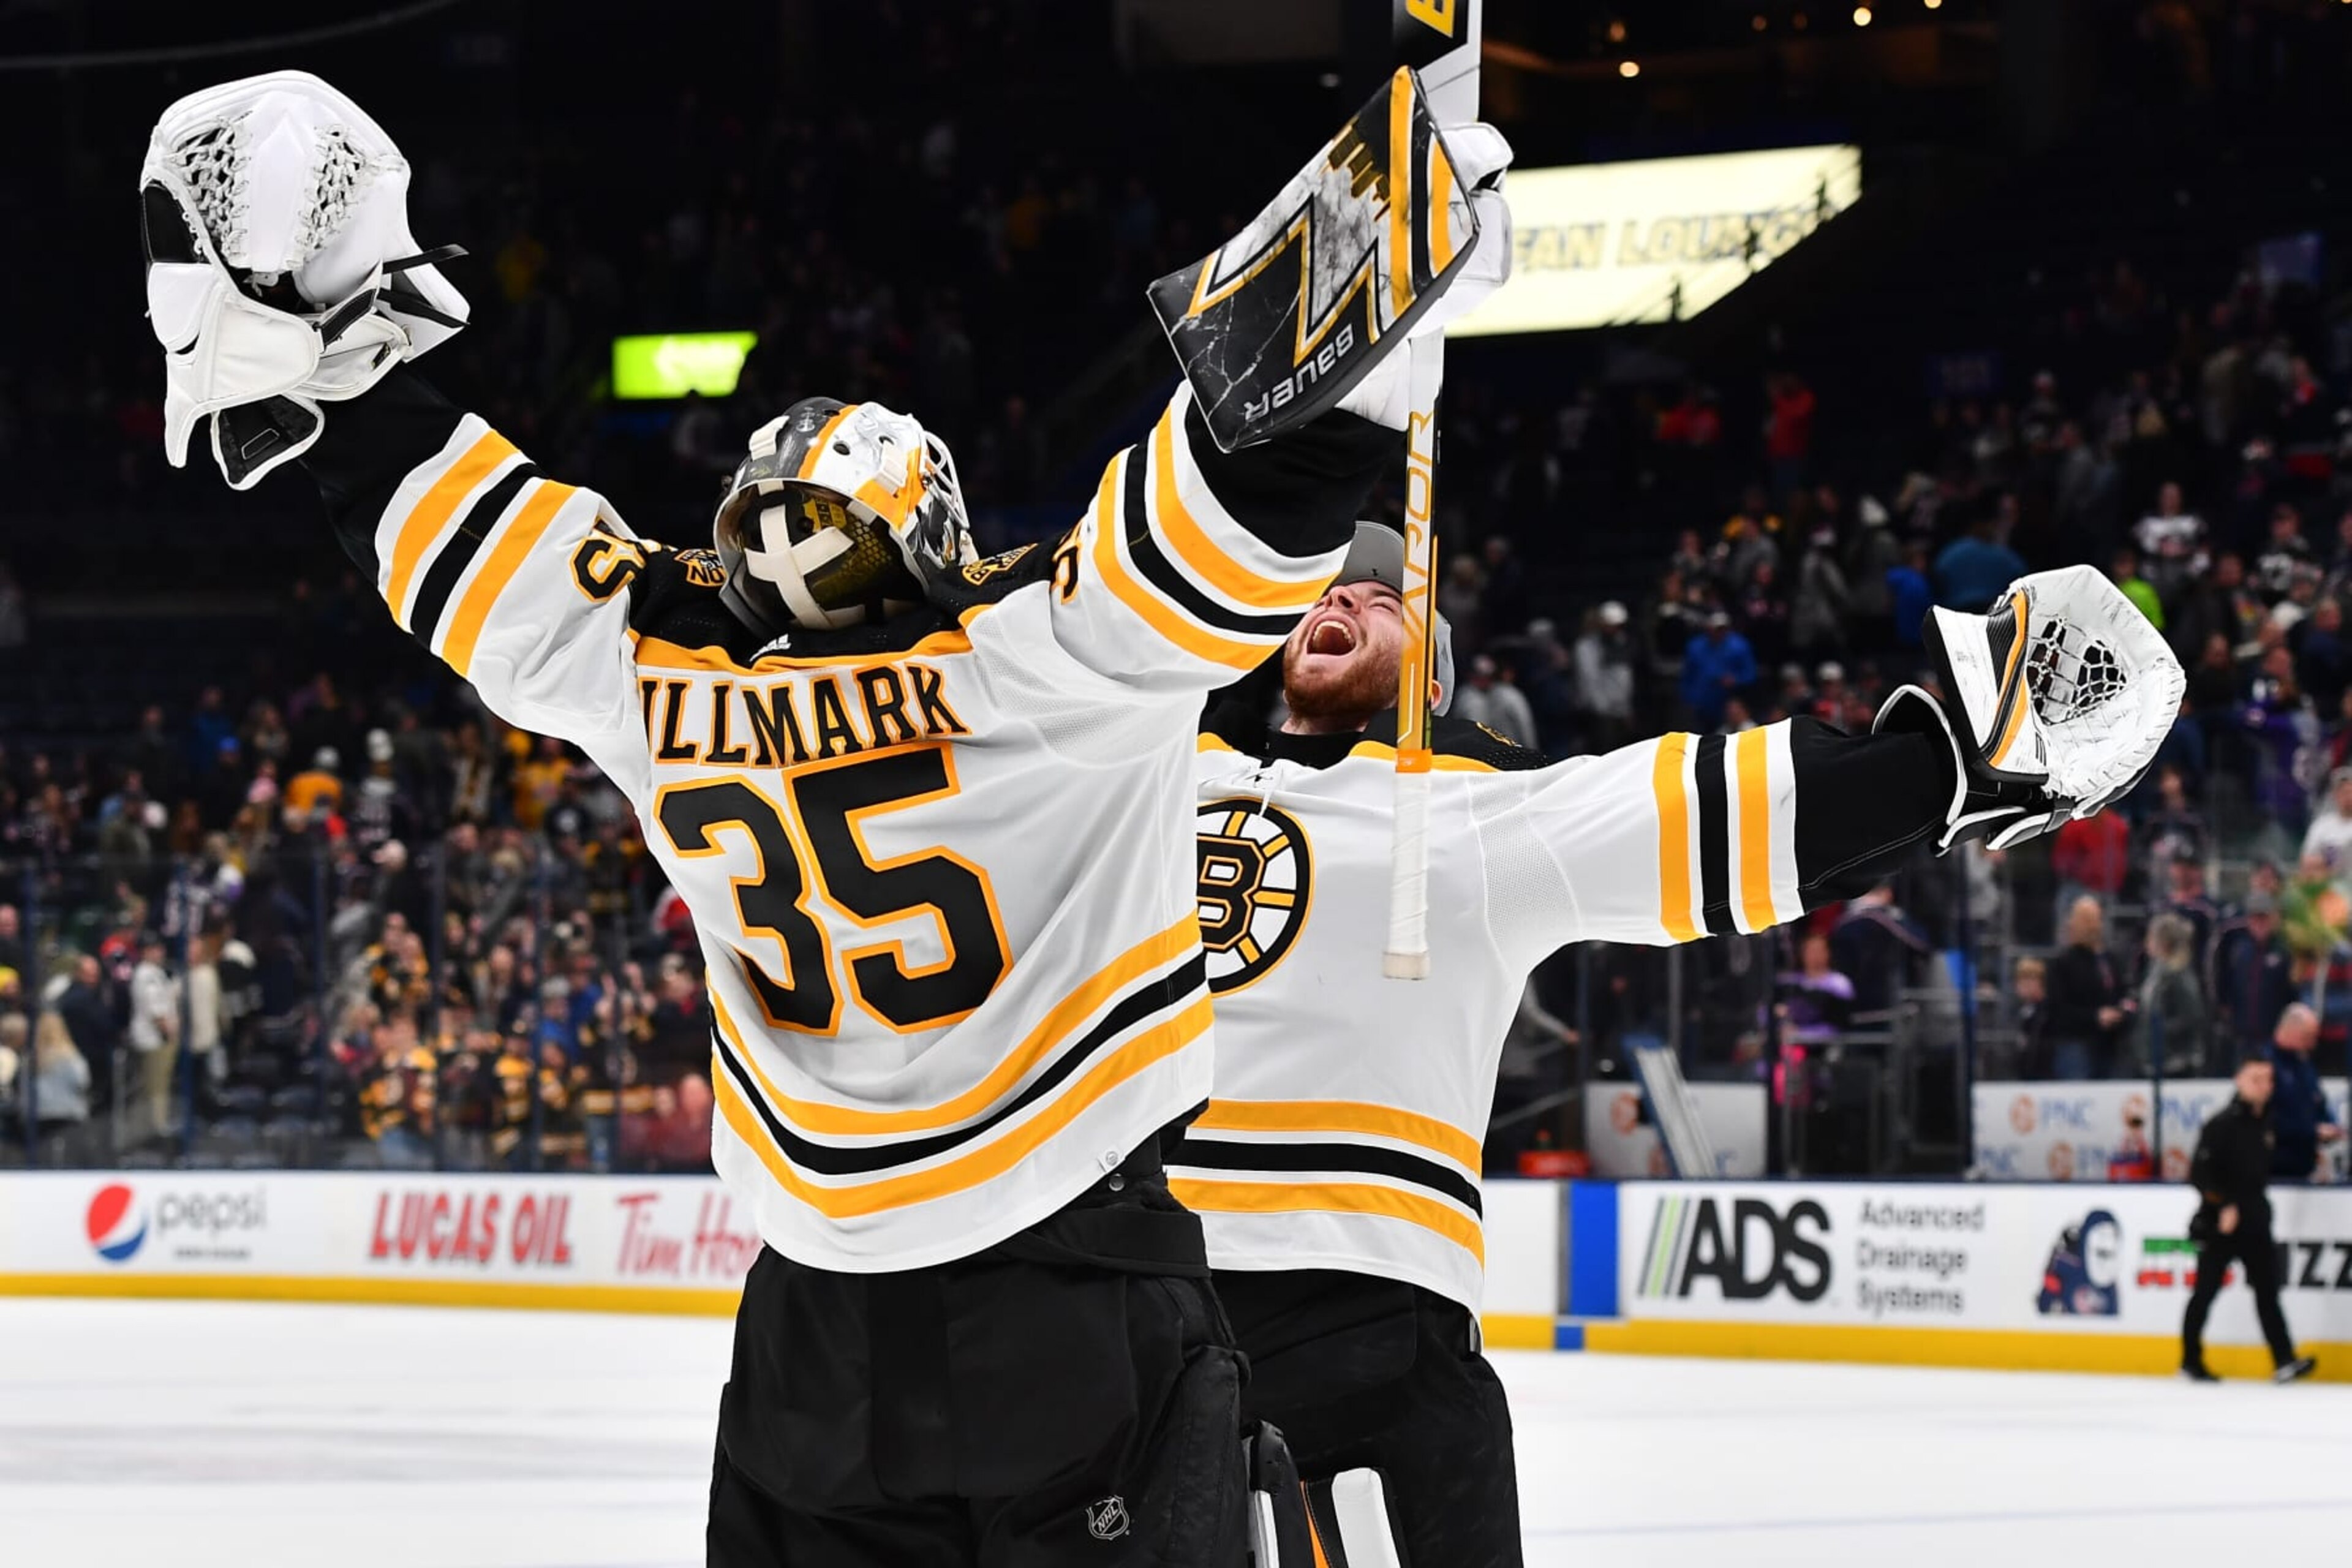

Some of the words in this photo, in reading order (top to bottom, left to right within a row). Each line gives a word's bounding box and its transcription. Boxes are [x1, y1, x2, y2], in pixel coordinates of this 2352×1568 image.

[654, 742, 1014, 1037] 35
[156, 1186, 268, 1241] pepsi
[370, 1191, 500, 1264] LUCAS
[512, 1194, 571, 1264] OIL
[614, 1191, 682, 1275] Tim
[1859, 1198, 1986, 1231] Advanced
[1677, 1197, 1834, 1303] ADS
[1856, 1238, 1967, 1281] Drainage
[1856, 1279, 1965, 1317] Systems
[1098, 1505, 1118, 1532] NHL
